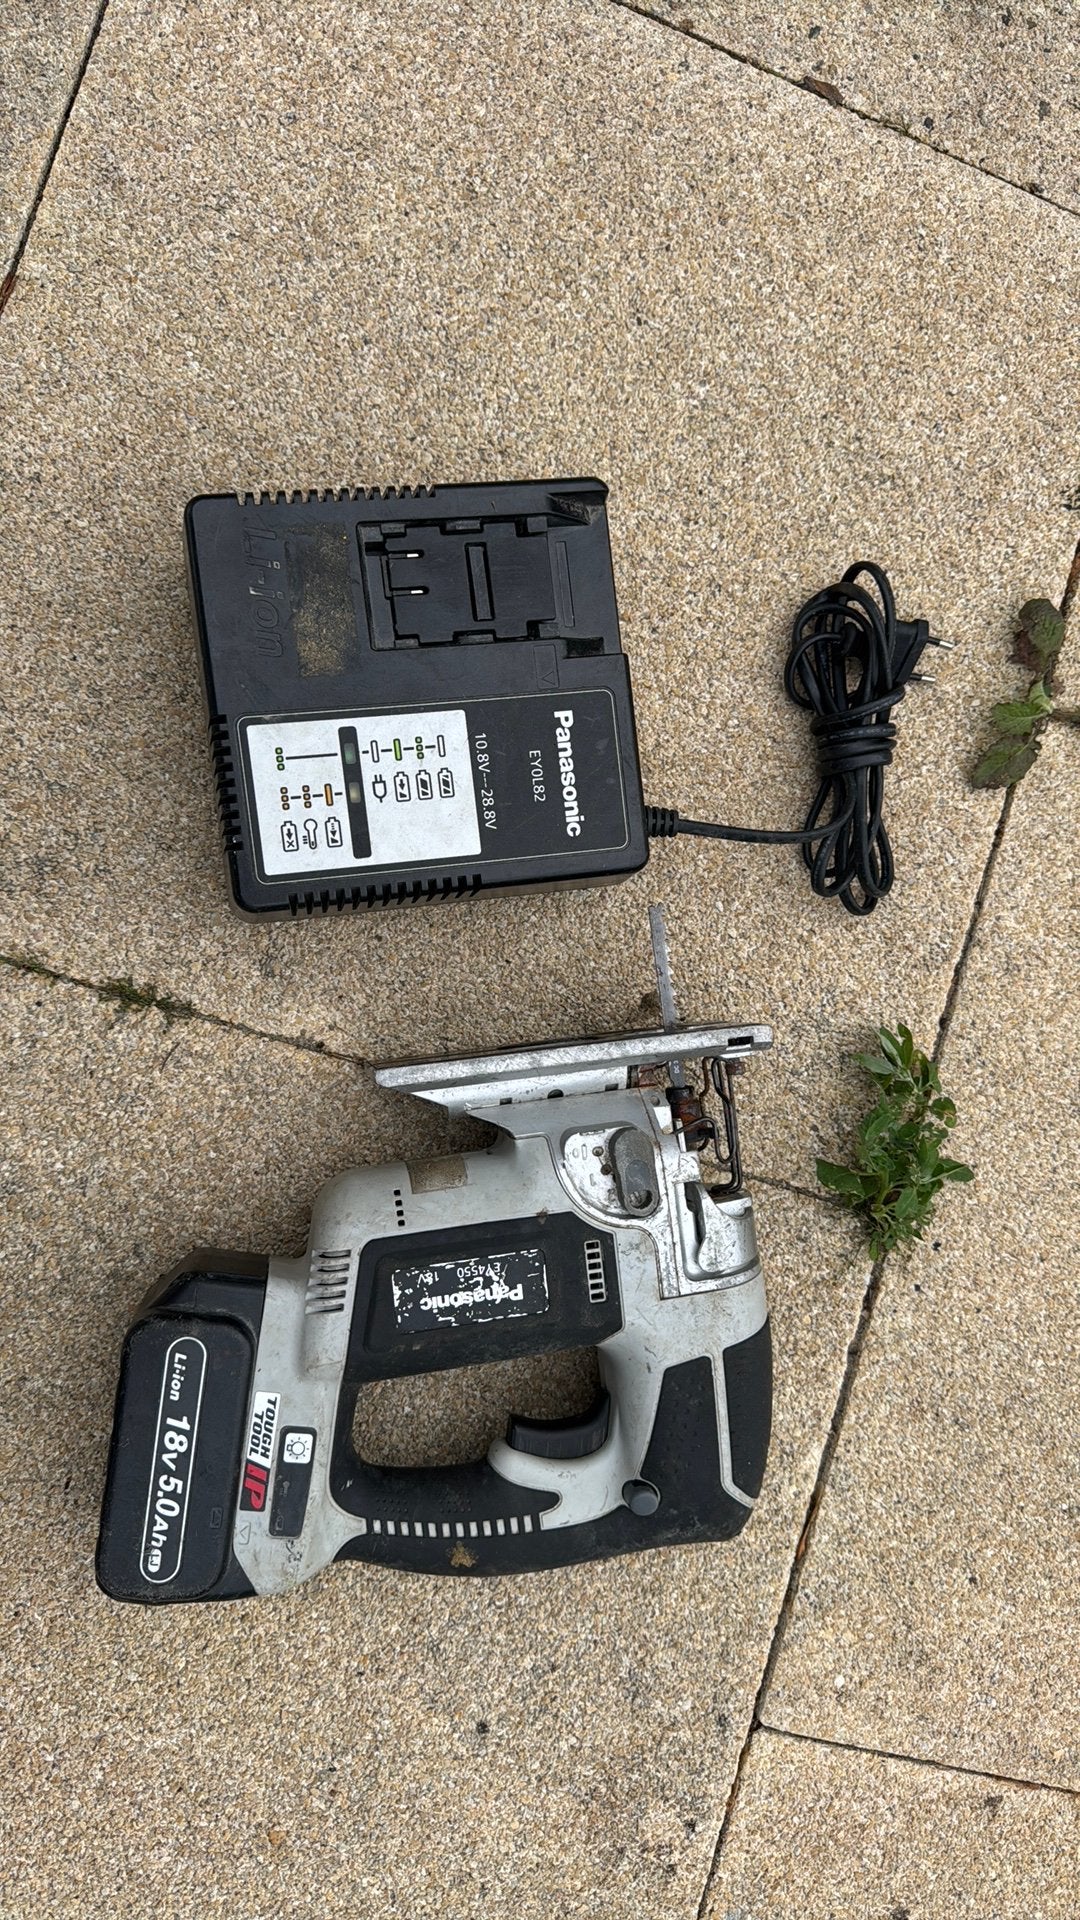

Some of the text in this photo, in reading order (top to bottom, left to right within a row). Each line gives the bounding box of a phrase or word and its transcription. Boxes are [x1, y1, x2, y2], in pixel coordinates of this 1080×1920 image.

[243, 525, 285, 658] Li-ion
[553, 709, 585, 837] Panasonic
[456, 1262, 502, 1279] EY4550
[419, 1283, 524, 1313] Panasonic
[169, 1352, 187, 1402] Li-ion
[248, 1410, 265, 1457] TOOL
[259, 1396, 278, 1460] TOUGH
[243, 1462, 268, 1510] IP
[151, 1474, 184, 1549] 5.0Ah
